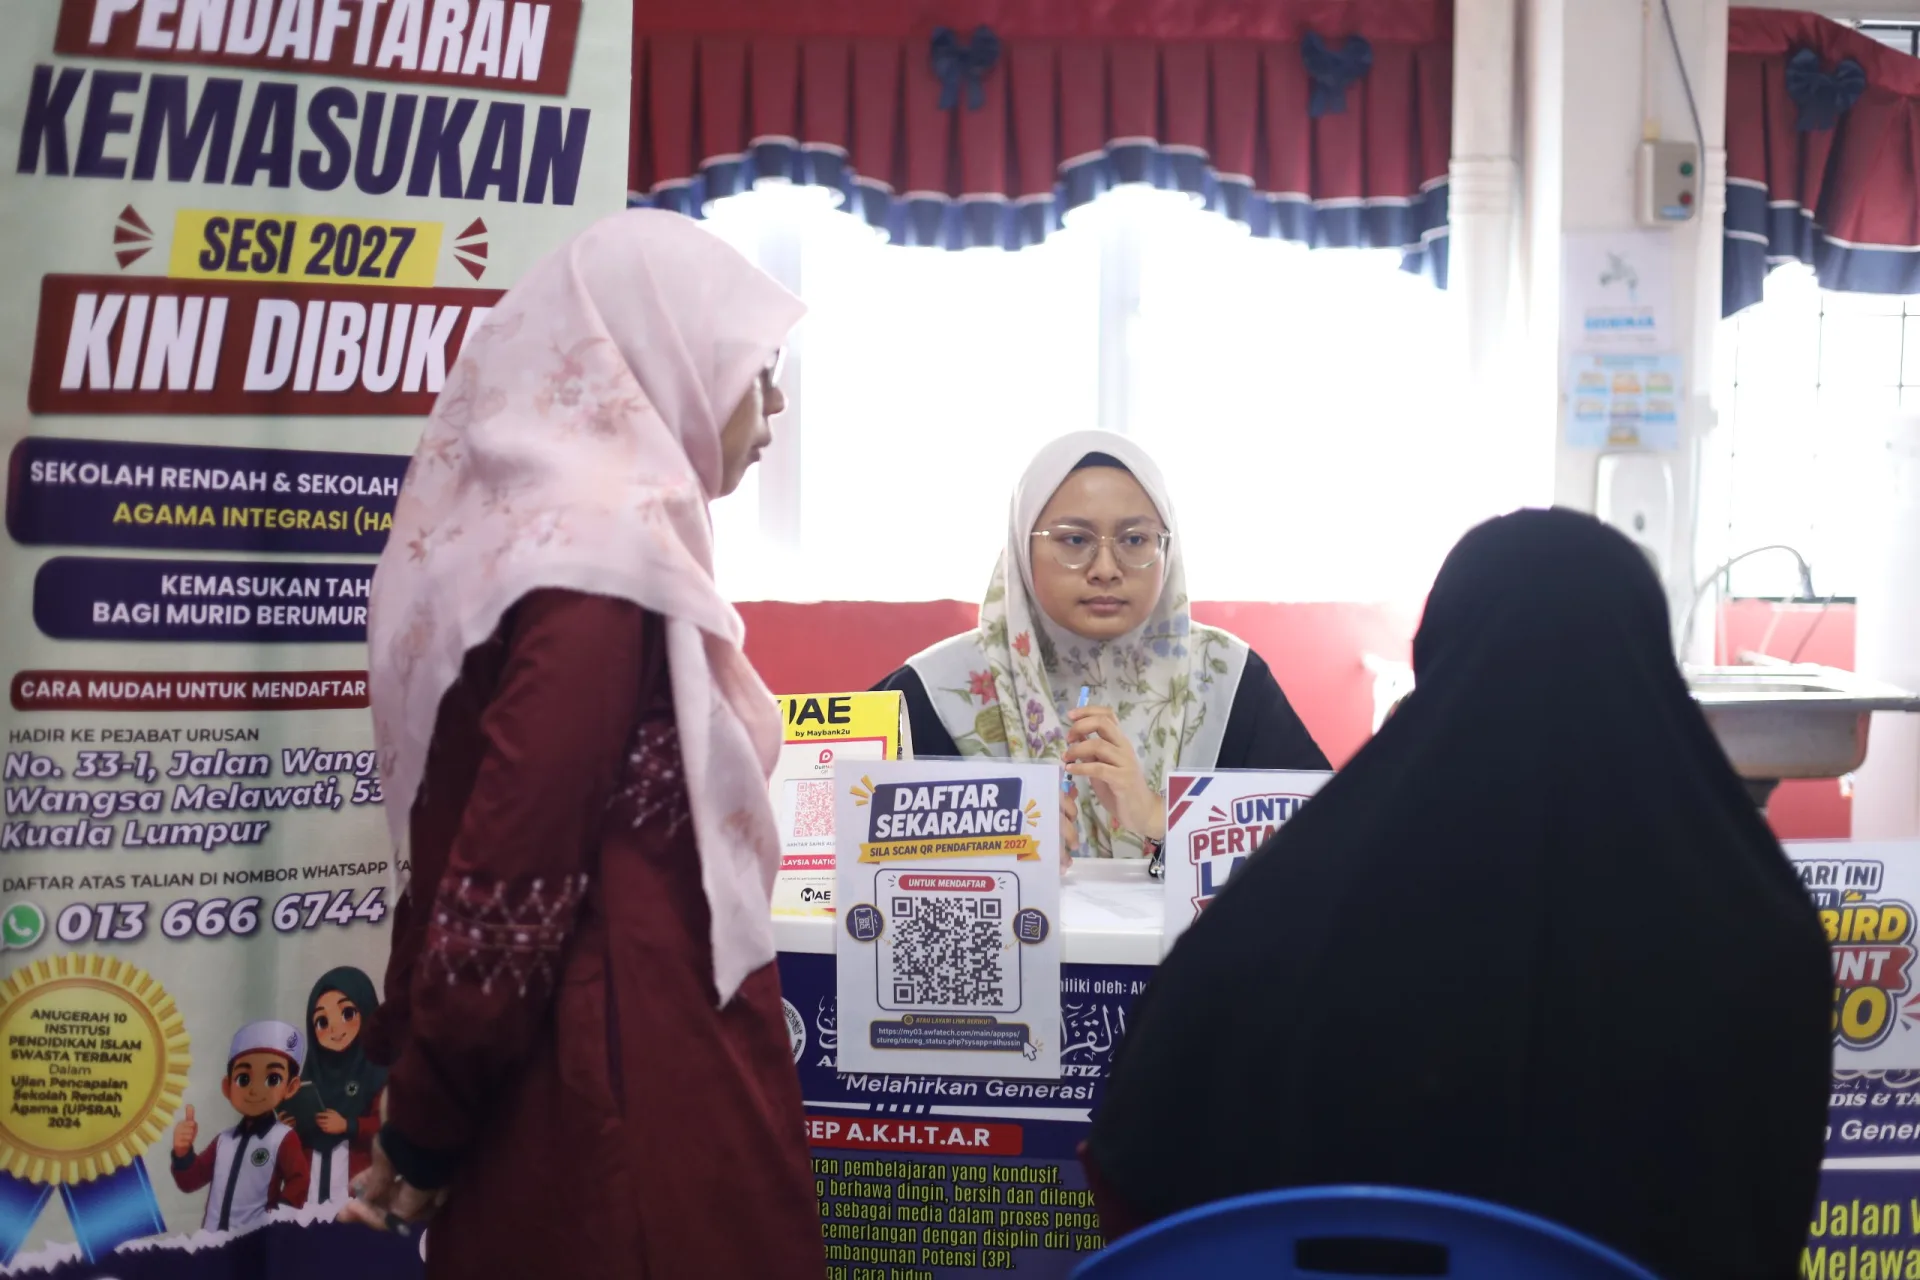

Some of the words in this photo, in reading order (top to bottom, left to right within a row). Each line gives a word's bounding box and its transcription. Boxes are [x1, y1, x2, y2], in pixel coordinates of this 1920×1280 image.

[88, 0, 551, 82] PENDAFTARAN
[16, 64, 592, 206] KEMASUKAN
[198, 217, 298, 274] SESI
[303, 222, 417, 279] 2027
[59, 292, 230, 392] KINI
[30, 461, 154, 487] SEKOLAH
[160, 467, 267, 492] RENDAH
[272, 472, 292, 493] &
[297, 472, 399, 497] SEKOLAH
[112, 501, 216, 526] AGAMA
[222, 506, 348, 532] INTEGRASI
[161, 574, 321, 597] KEMASUKAN
[92, 602, 160, 625] BAGI
[166, 604, 251, 626] MURID
[256, 604, 368, 626] BERUMUR
[20, 680, 82, 699] CARA
[87, 681, 172, 699] MUDAH
[176, 681, 247, 699] UNTUK
[252, 680, 367, 698] MENDAFTAR
[780, 696, 852, 726] AE
[9, 728, 66, 744] HADIR
[70, 728, 96, 743] KE
[101, 728, 182, 743] PEJABAT
[186, 728, 260, 743] URUSAN
[795, 730, 805, 738] by
[806, 728, 851, 737] Maybank2u
[3, 750, 64, 781] No.
[73, 750, 158, 783] 33-1,
[166, 747, 271, 778] Jalan
[281, 745, 381, 777] Wang
[3, 784, 163, 818] Wangsa
[171, 775, 343, 811] Melawati,
[892, 783, 1000, 813] DAFTAR
[1, 819, 113, 851] Kuala
[121, 819, 271, 851] Lumpur
[874, 808, 1020, 840] SEKARANG!
[869, 845, 891, 858] SILA
[892, 844, 918, 857] SCAN
[919, 843, 934, 856] QR
[935, 840, 1002, 855] PENDAFTARAN
[1003, 838, 1028, 851] 2027
[781, 858, 810, 866] LAYSIA
[2, 875, 74, 893] DAFTAR
[78, 874, 126, 891] ATAS
[130, 873, 195, 890] TALIAN
[199, 872, 217, 887] DI
[222, 867, 299, 886] NOMBOR
[302, 859, 388, 879] WHATSAPP
[908, 877, 936, 889] UNTUK
[937, 878, 987, 890] MENDAFTAR
[1844, 865, 1879, 887] INI
[56, 902, 147, 944] 013
[160, 897, 262, 940] 666
[271, 887, 390, 934] 6744
[1818, 906, 1908, 944] BIRD
[1094, 979, 1127, 995] oleh:
[30, 1009, 110, 1023] ANUGERAH
[113, 1012, 128, 1024] 10
[45, 1023, 111, 1036] INSTITUSI
[9, 1035, 97, 1049] PENDIDIKAN
[100, 1039, 142, 1051] ISLAM
[10, 1048, 70, 1061] SWASTA
[74, 1051, 133, 1064] TERBAIK
[49, 1063, 92, 1076] Dalam
[11, 1075, 46, 1090] Ujian
[50, 1077, 129, 1091] Pencapaian
[985, 1079, 1096, 1100] Generasi
[13, 1089, 67, 1101] Sekolah
[71, 1090, 123, 1103] Rendah
[1870, 1092, 1892, 1107] &
[10, 1102, 59, 1117] Agama
[47, 1116, 82, 1129] 2024
[846, 1122, 991, 1147] A.K.H.T.A.R
[810, 1158, 838, 1175] ran
[844, 1159, 947, 1181] pembelajaran
[951, 1165, 988, 1184] yang
[992, 1164, 1064, 1185] kondusif.
[829, 1178, 893, 1200] berhawa
[897, 1182, 950, 1205] dingin,
[954, 1184, 1002, 1204] bersih
[1006, 1186, 1035, 1206] dan
[1039, 1187, 1096, 1209] dilengk
[834, 1200, 893, 1223] sebagai
[897, 1204, 944, 1223] media
[948, 1206, 995, 1226] dalam
[999, 1209, 1050, 1228] proses
[1809, 1198, 1901, 1238] Jalan
[922, 1225, 978, 1248] dengan
[982, 1228, 1039, 1249] disiplin
[1043, 1230, 1070, 1250] diri
[921, 1247, 977, 1268] Potensi
[981, 1249, 1016, 1270] (3P).
[853, 1266, 886, 1280] cara
